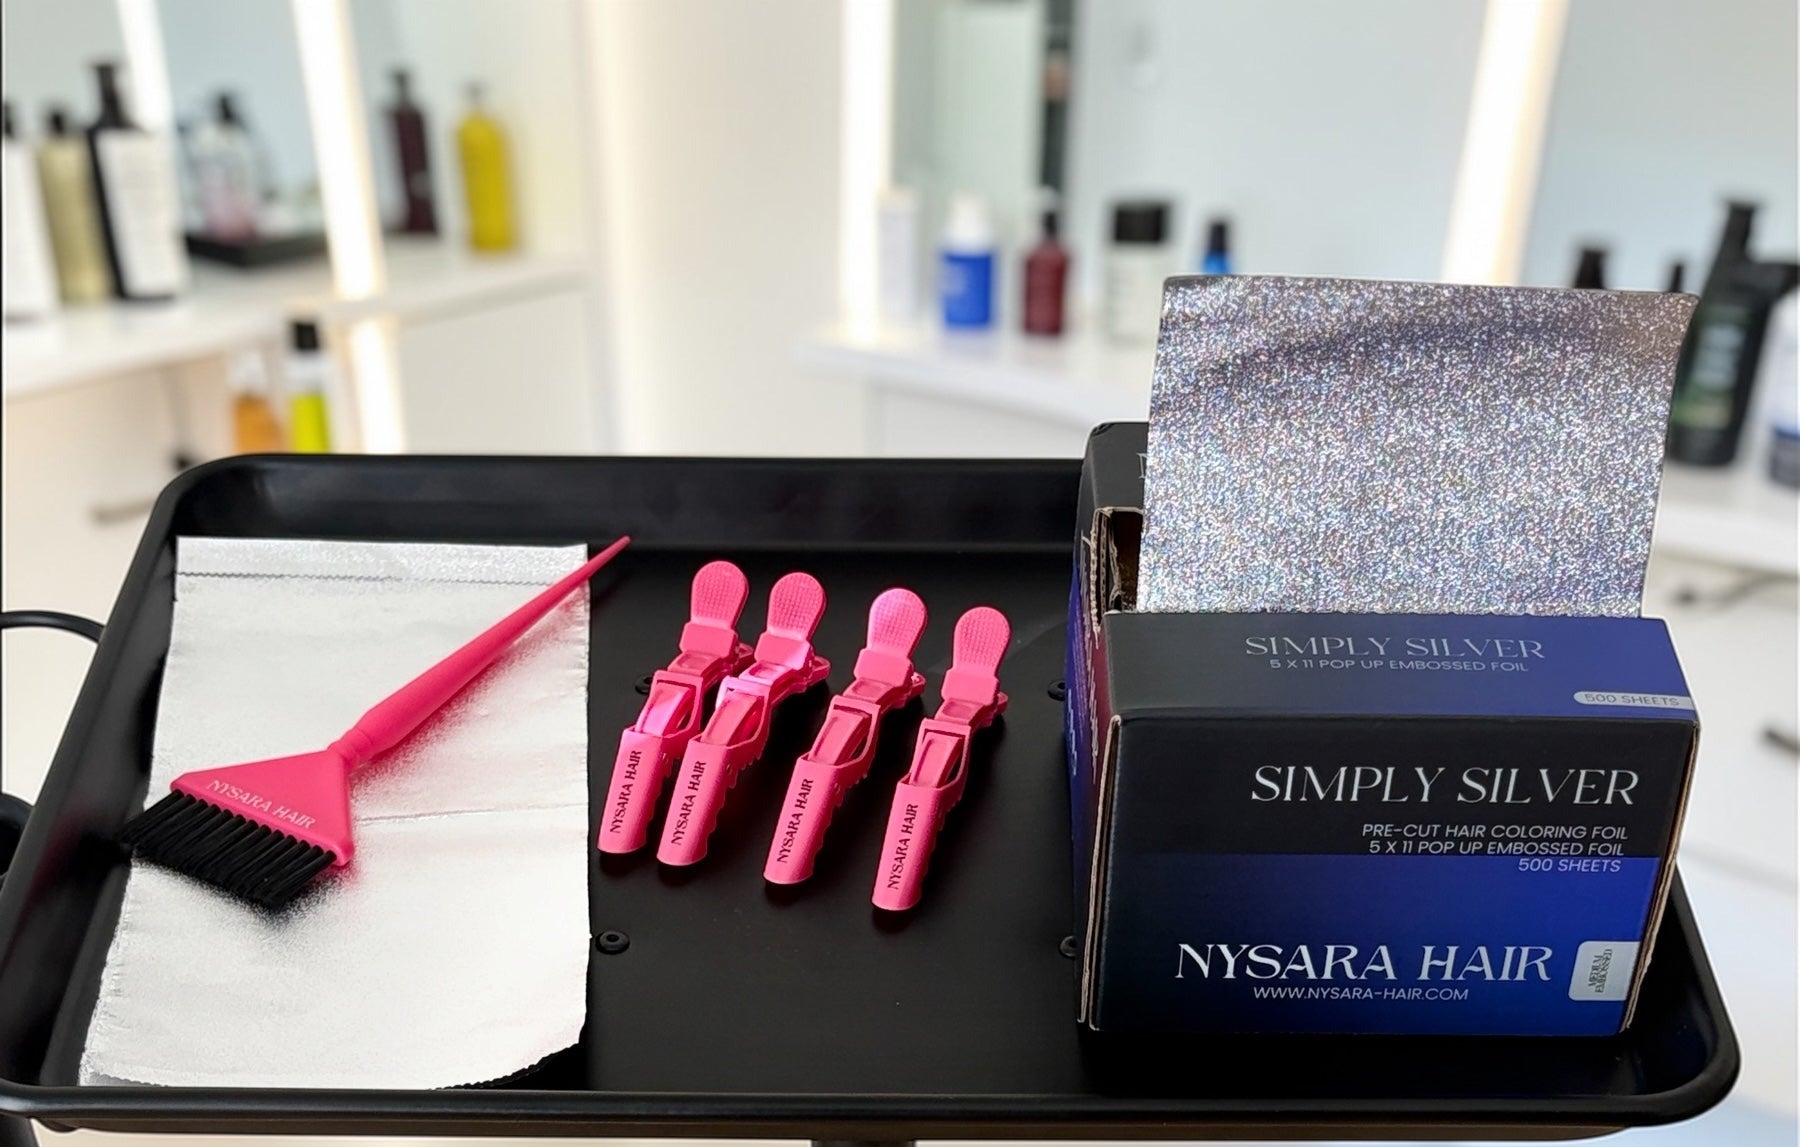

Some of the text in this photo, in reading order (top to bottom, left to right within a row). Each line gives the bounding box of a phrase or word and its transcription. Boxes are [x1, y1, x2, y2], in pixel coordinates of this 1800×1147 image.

[1245, 636, 1545, 659] SIMPLY SILVER
[1270, 659, 1529, 672] 5 X 11 POP UP EMBOSSED FOIL
[1584, 693, 1679, 706] 500 SHEETS
[609, 750, 642, 834] NYSARA HAIR
[1252, 766, 1639, 805] SIMPLY SILVER
[206, 780, 316, 829] NYSARA HAIR
[671, 761, 706, 846] NYSARA HAIR
[777, 778, 814, 864] NYSARA HAIR
[1362, 823, 1628, 839] PRE-CUT HAIR COLORING FOIL
[887, 803, 918, 890] NYSARA HAIR
[1369, 840, 1624, 856] 5 X 11 POP UP EMBOSSED FOIL
[1518, 858, 1621, 873] 500 SHEETS
[1174, 943, 1553, 981] NYSARA HAIR
[1254, 986, 1469, 1001] WWW.NYSARA-HAIR.COM
